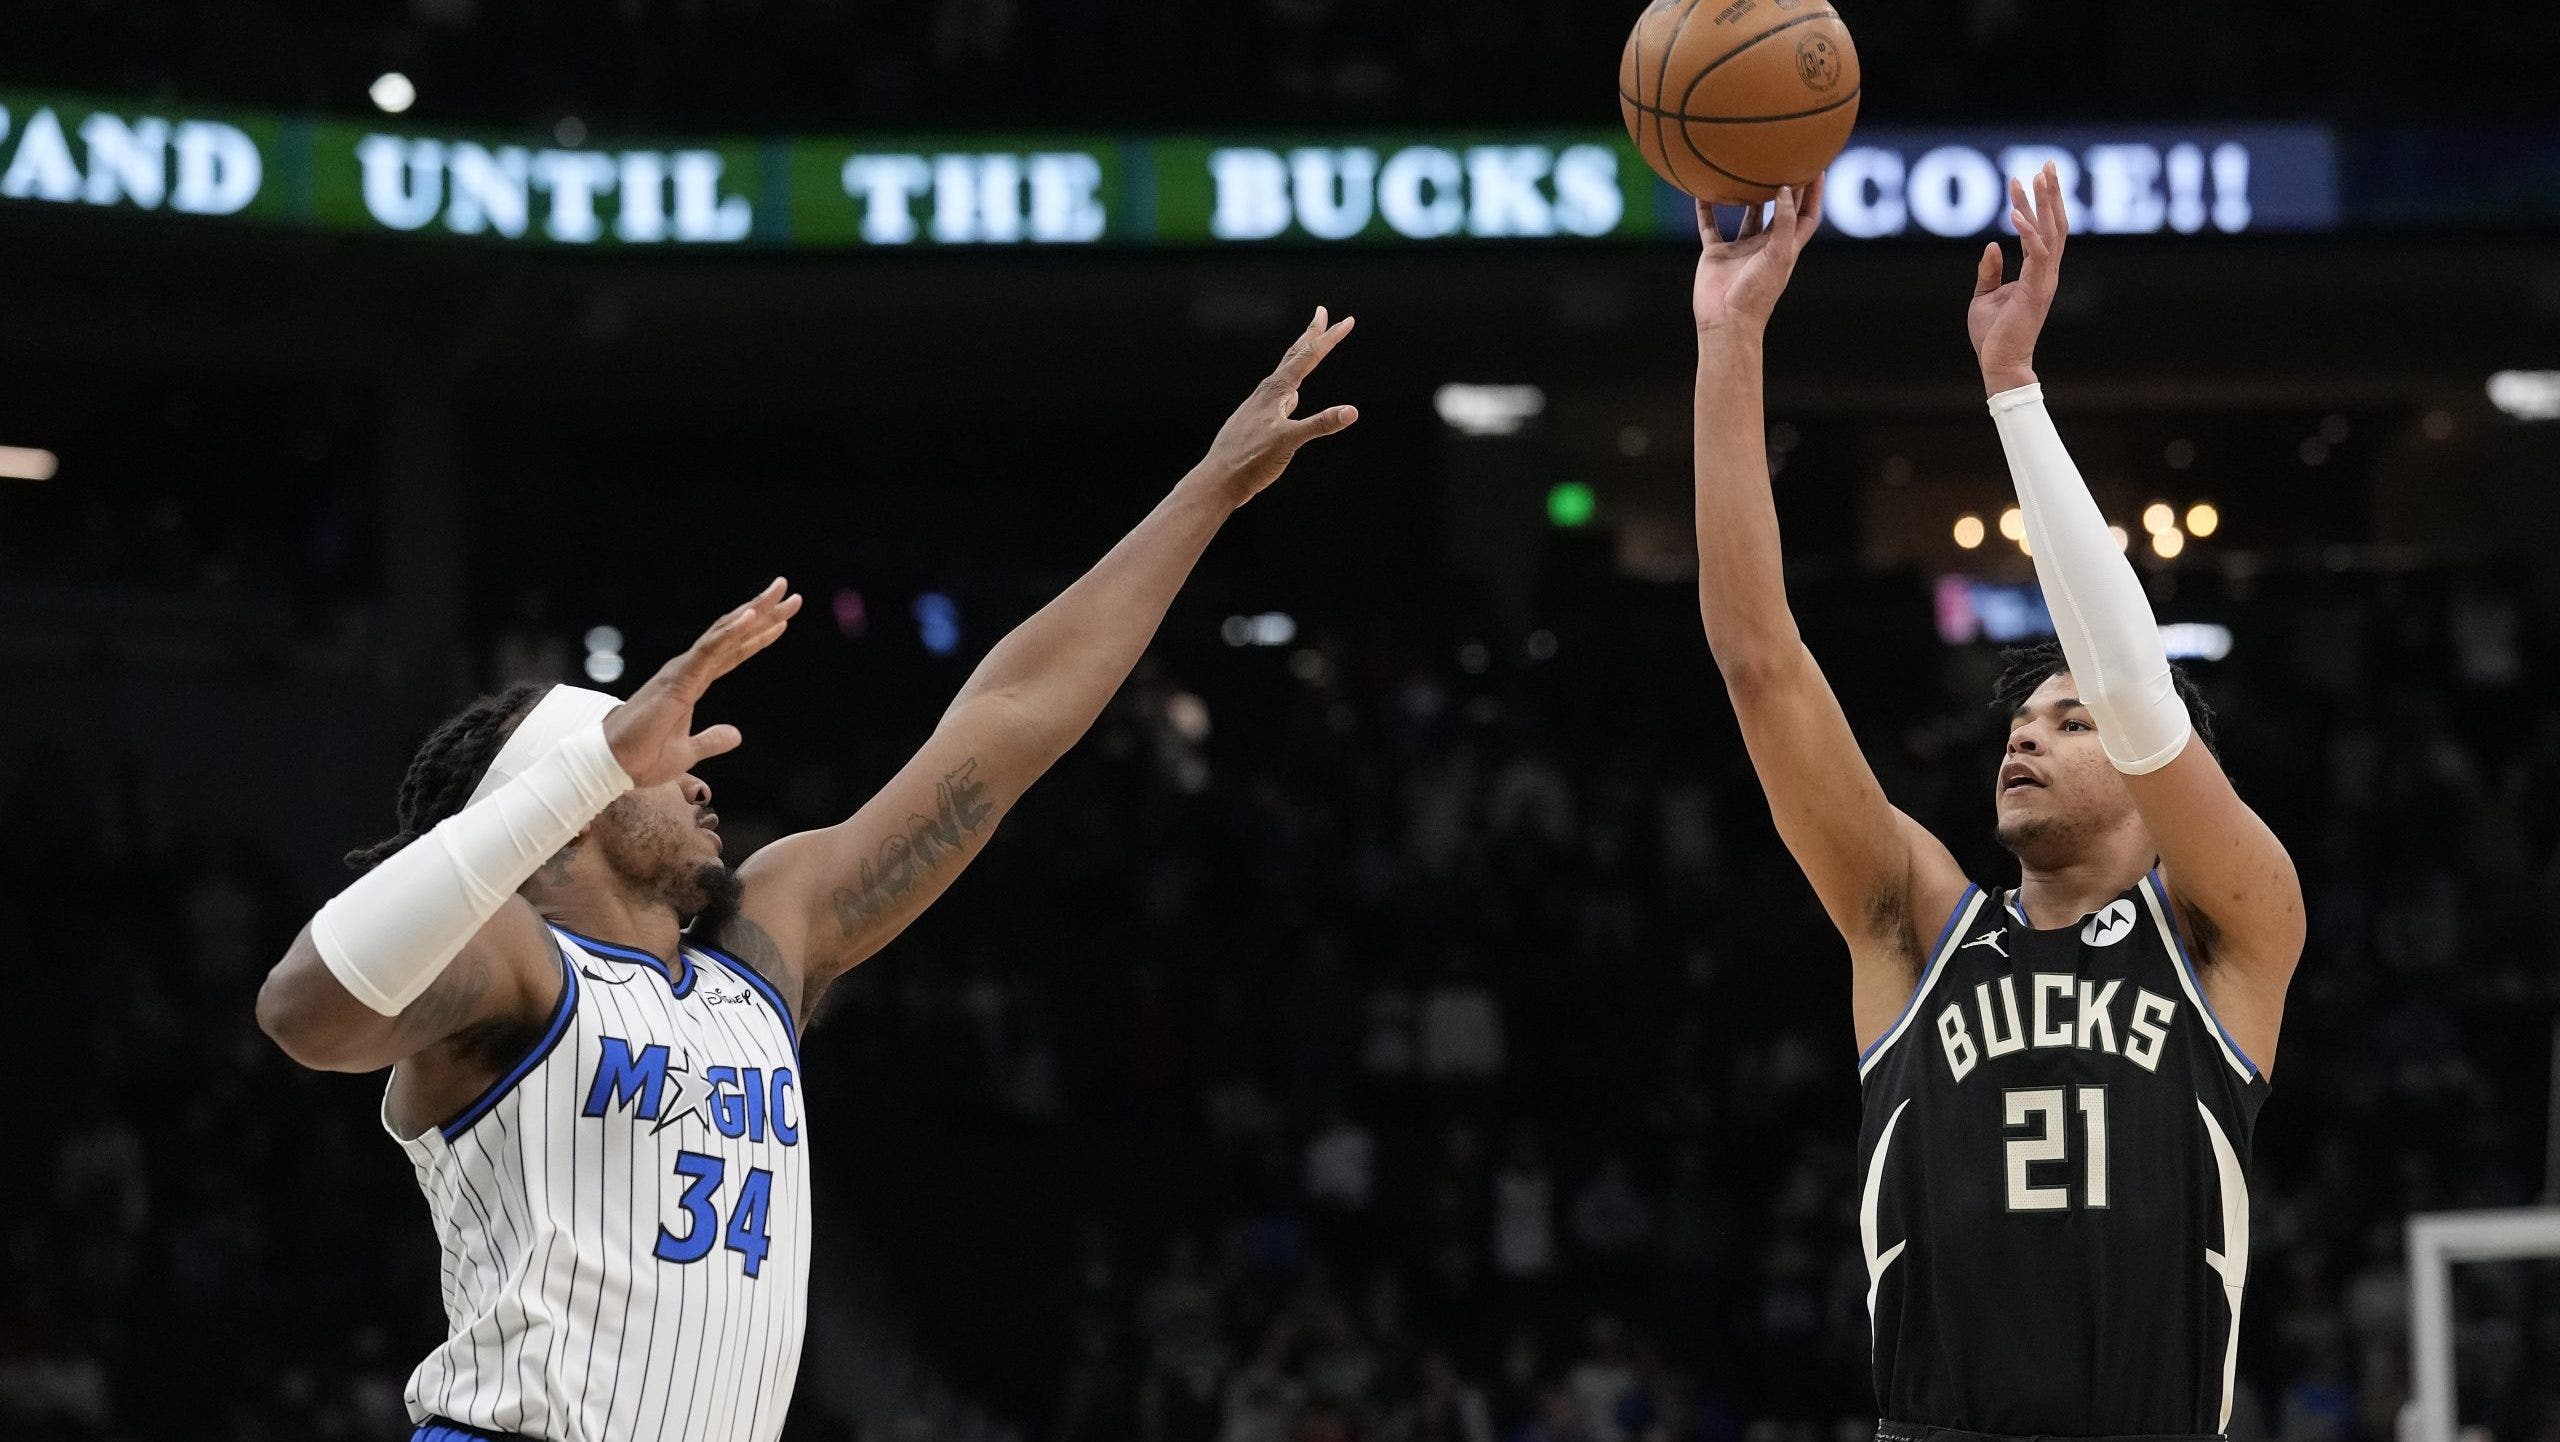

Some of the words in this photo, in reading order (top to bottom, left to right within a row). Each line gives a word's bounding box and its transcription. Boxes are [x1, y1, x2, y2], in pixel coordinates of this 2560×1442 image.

[0, 105, 264, 216] AND
[354, 132, 753, 244] UNTIL
[841, 151, 1107, 244] THE
[1209, 143, 1625, 240] BUCKS
[1763, 142, 2253, 239] CORE!!
[1936, 970, 2179, 1085] BUCKS
[2002, 1083, 2111, 1213] 21
[652, 1149, 774, 1280] 34
